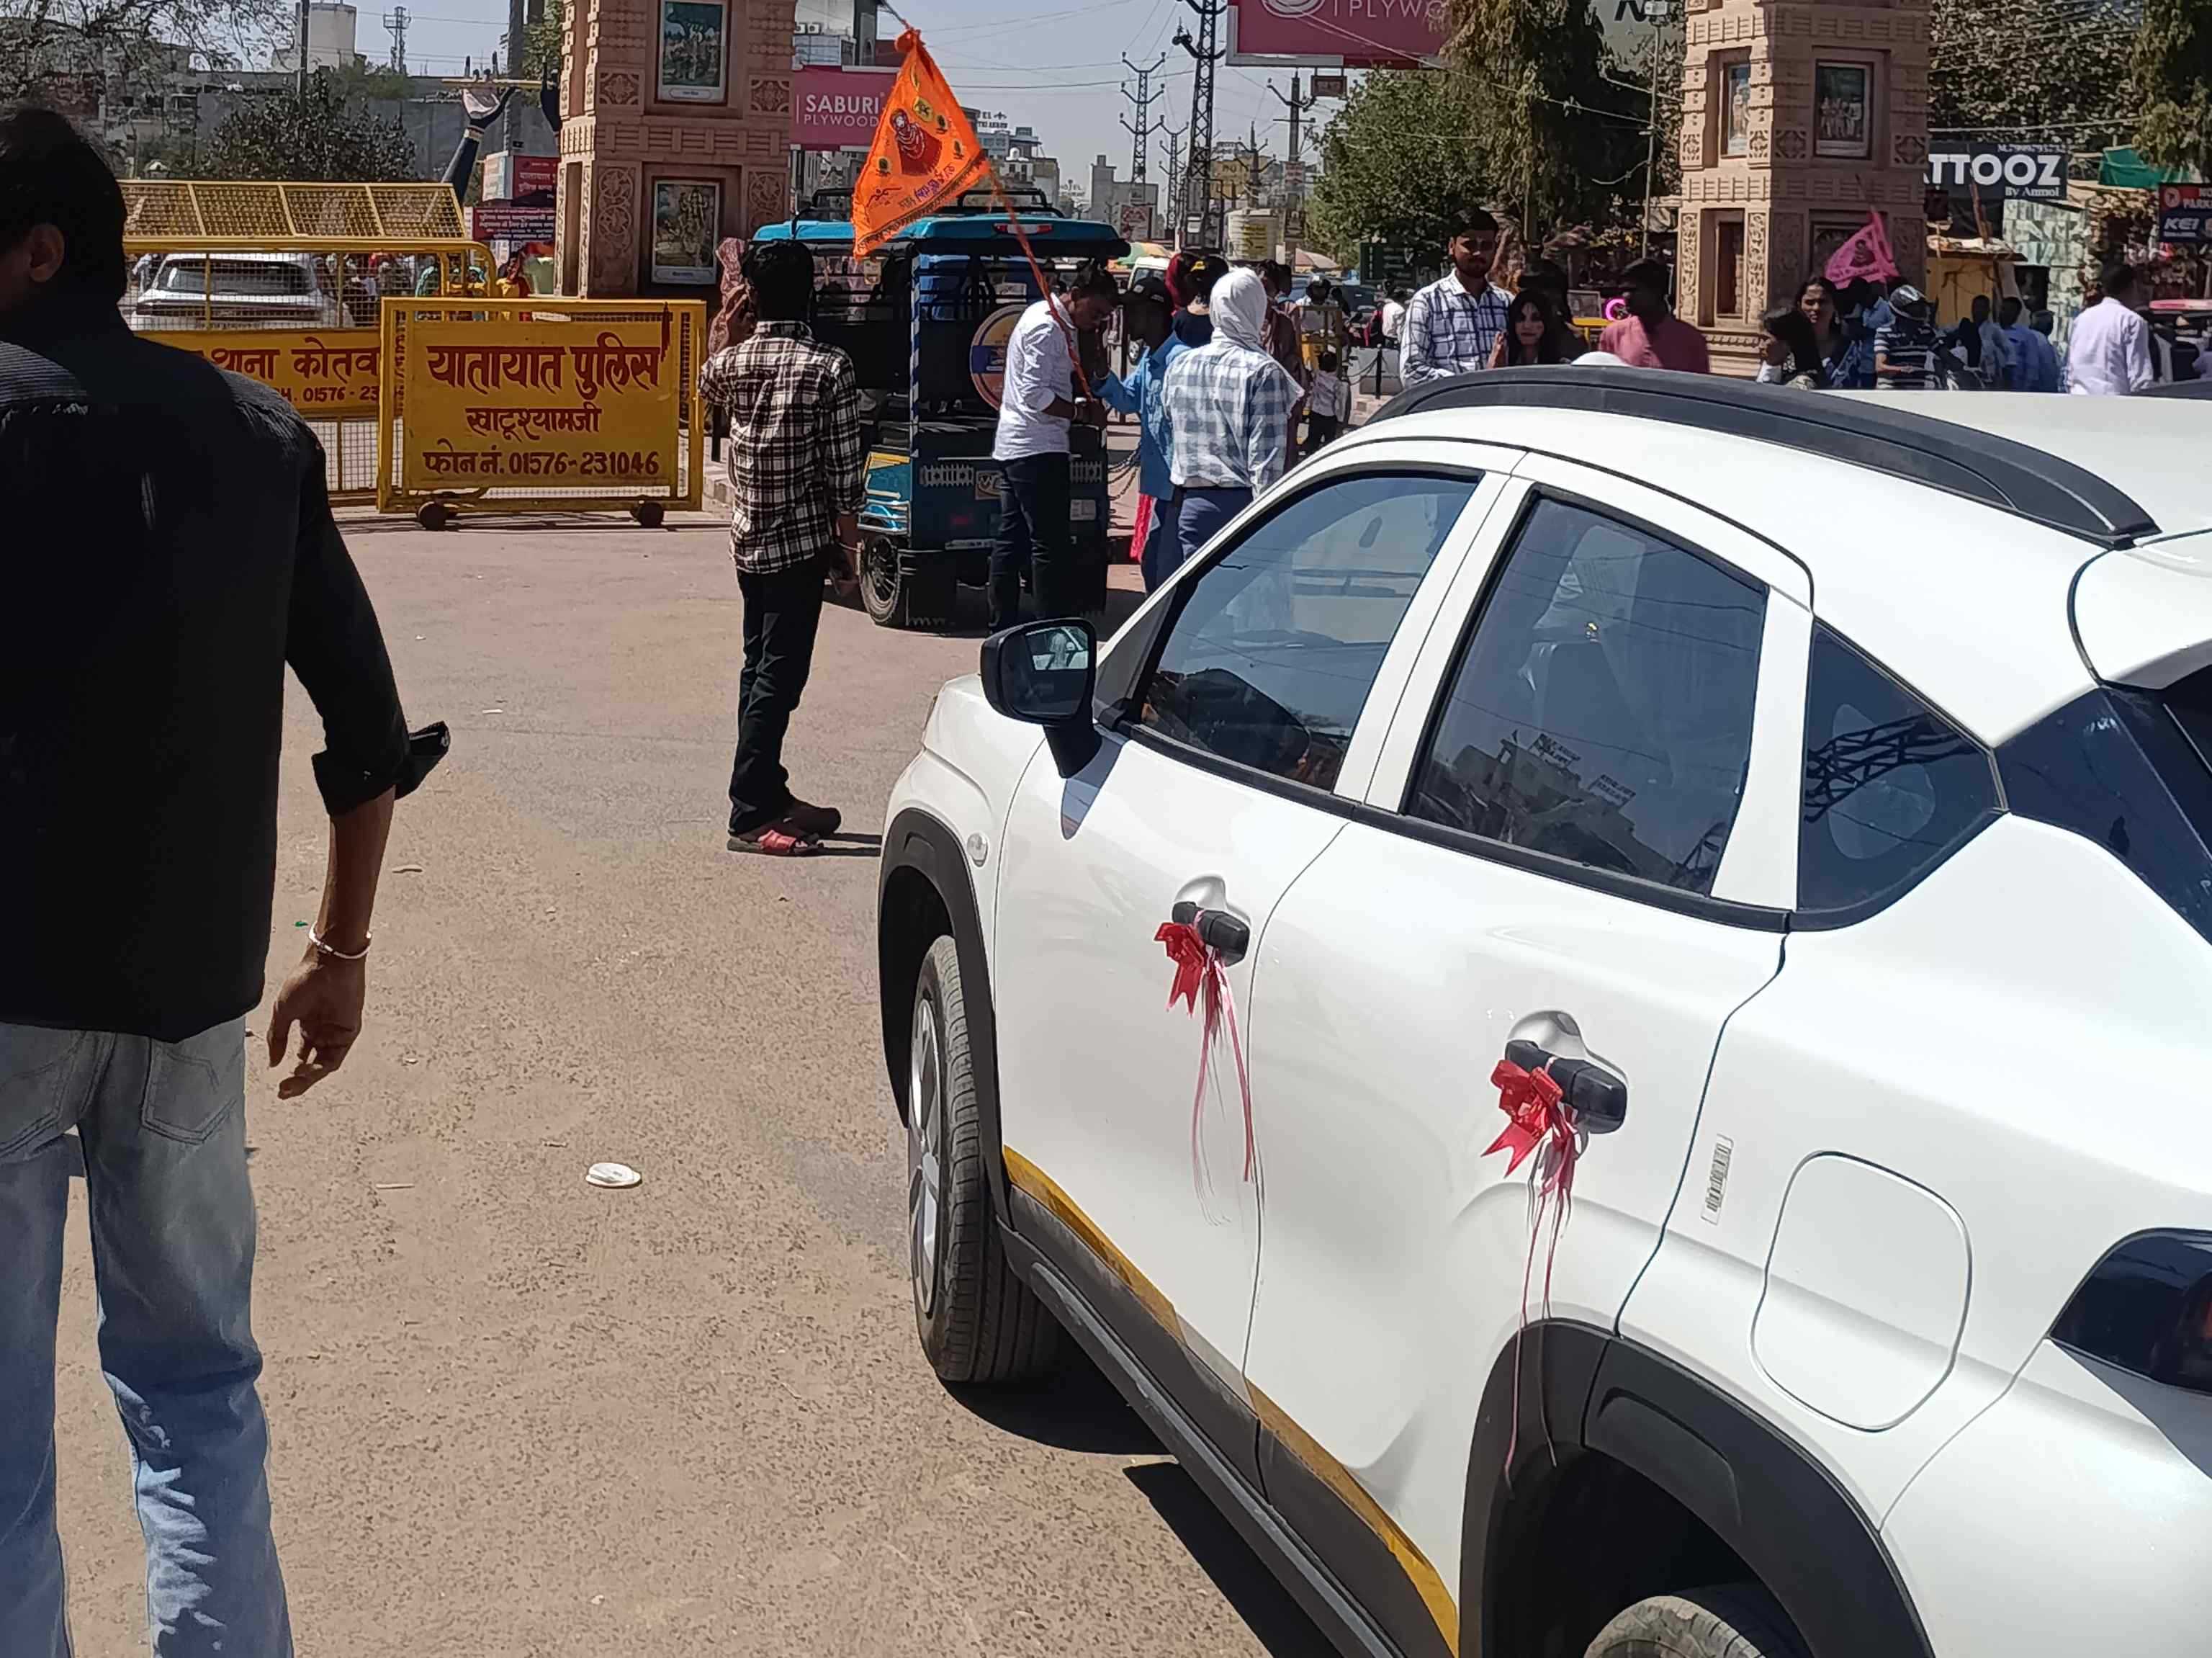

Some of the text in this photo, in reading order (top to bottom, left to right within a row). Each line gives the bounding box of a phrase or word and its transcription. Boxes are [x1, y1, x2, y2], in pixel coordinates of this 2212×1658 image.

[806, 94, 879, 114] SABURI
[804, 115, 879, 127] PLYWOOD
[1923, 153, 2062, 186] TTOOZ
[426, 331, 661, 400] यातायात पुलिस
[303, 386, 345, 402] 01576
[423, 438, 478, 475] फोन
[508, 451, 660, 475] 01576-231046
